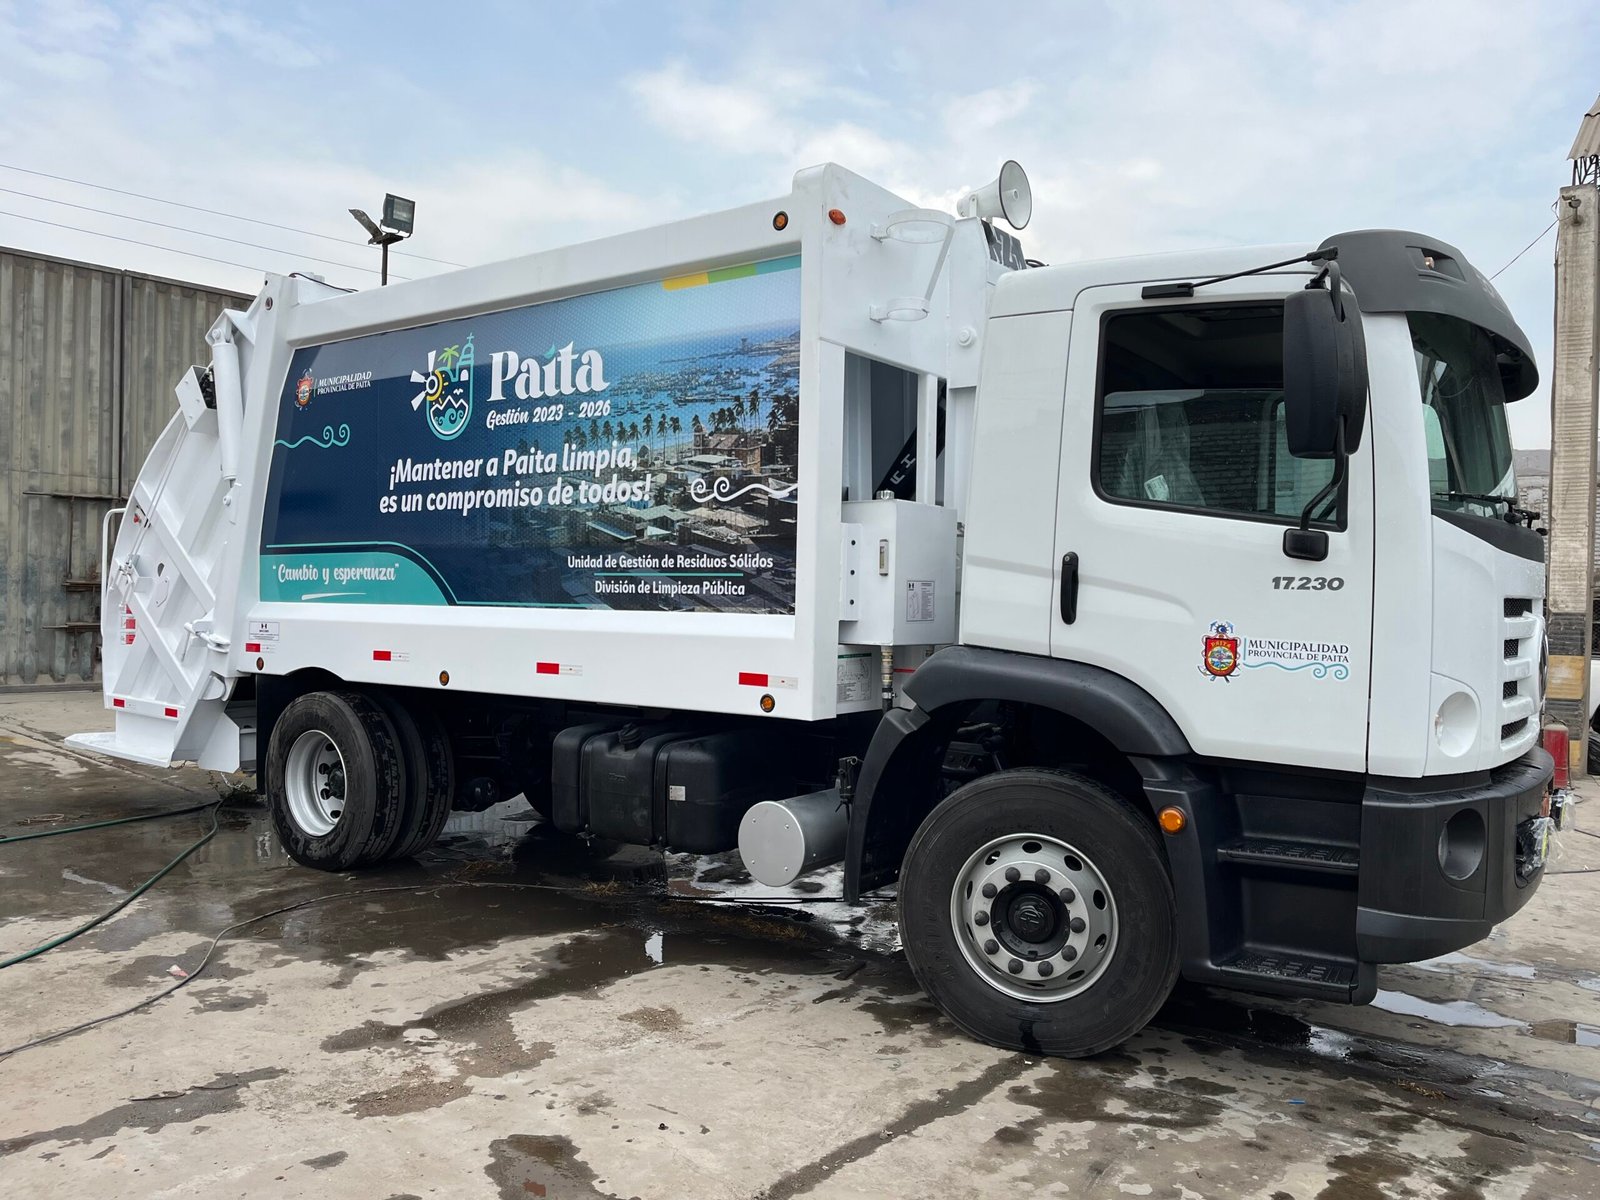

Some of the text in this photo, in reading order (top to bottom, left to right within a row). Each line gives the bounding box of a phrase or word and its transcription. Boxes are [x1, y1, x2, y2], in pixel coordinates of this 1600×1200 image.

[318, 371, 372, 387] MUNICIPALIDAD
[486, 340, 611, 402] Paita
[317, 380, 371, 395] PROVINCIAL DE PAITA
[486, 407, 530, 430] Gestión
[532, 403, 564, 423] 2023
[578, 399, 612, 419] 2026
[389, 440, 638, 490] ¡Mantener a Paita limpia,
[379, 473, 652, 516] es un compromiso de todos!
[567, 553, 774, 568] Unidad de Gestión de Residuos Sólidos
[322, 567, 330, 585] y
[1271, 576, 1345, 591] 17.230
[595, 580, 746, 598] División de Limpieza Pública
[1248, 639, 1350, 655] MUNICIPALIDAD
[1248, 650, 1349, 663] PROVINCIAL DE PAITA
